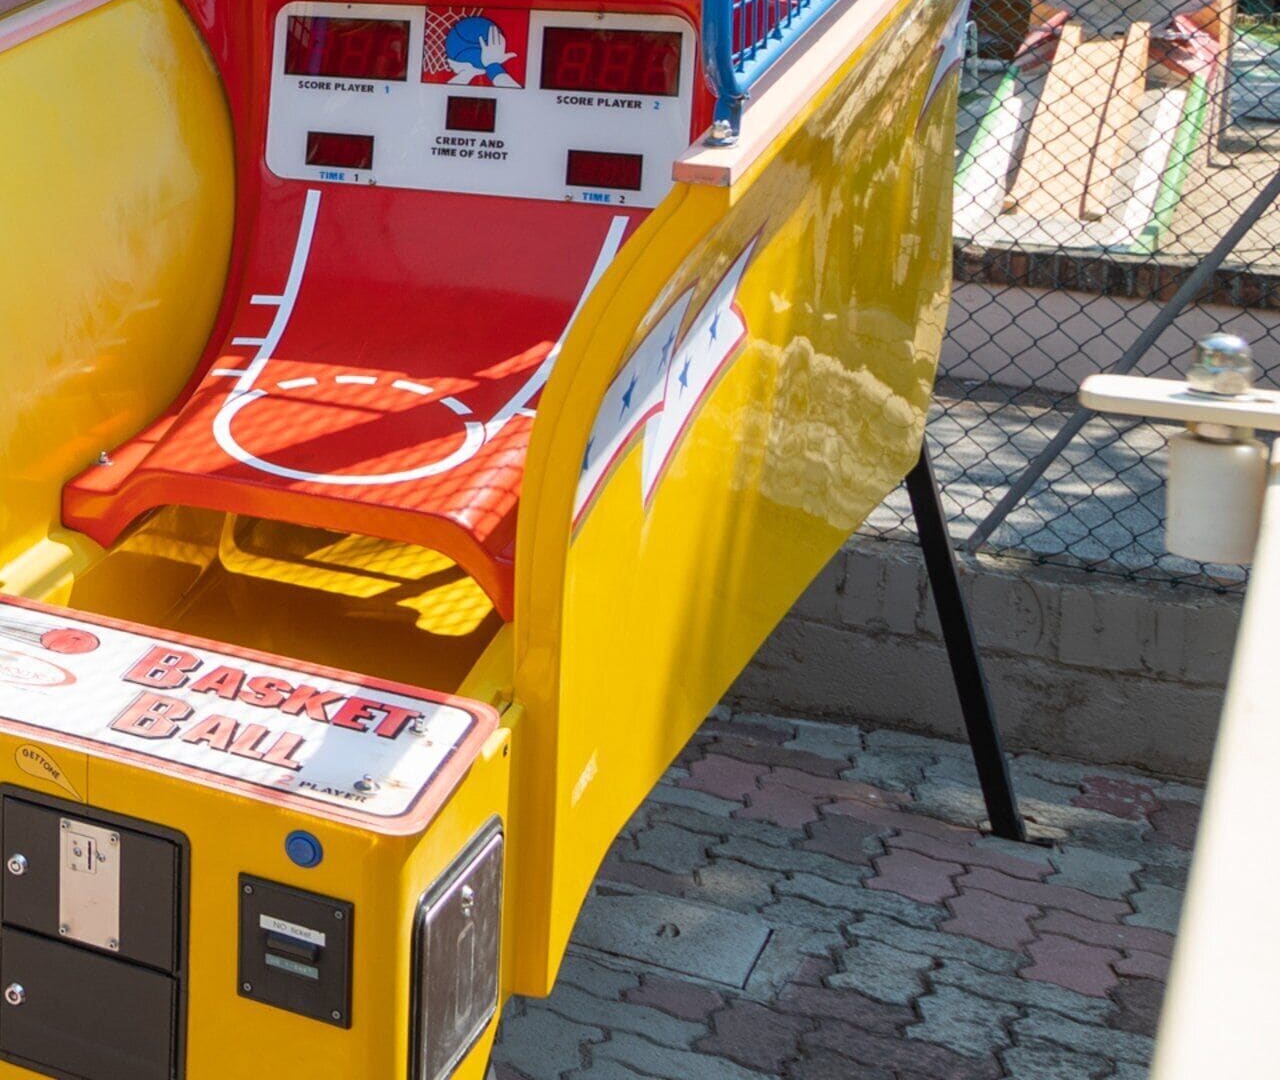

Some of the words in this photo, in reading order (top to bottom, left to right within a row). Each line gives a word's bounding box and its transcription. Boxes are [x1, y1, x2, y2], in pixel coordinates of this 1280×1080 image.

[297, 80, 332, 91] SCORE
[334, 82, 375, 94] PLAYER
[384, 85, 390, 94] 1
[556, 95, 593, 108] SCORE
[596, 97, 643, 110] PLAYER
[652, 100, 661, 110] 2
[435, 136, 477, 147] CREDIT
[479, 138, 505, 149] AND
[430, 147, 458, 157] TIME
[459, 149, 475, 158] OF
[477, 150, 509, 161] SHOT
[318, 170, 345, 182] TIME
[353, 173, 359, 182] 1
[582, 192, 611, 204] TIME
[618, 195, 626, 204] 2
[121, 643, 425, 740] BASKET
[107, 690, 307, 771] BALL
[21, 748, 61, 780] GETTONE
[273, 774, 296, 787] 2
[298, 780, 368, 804] PLAYER
